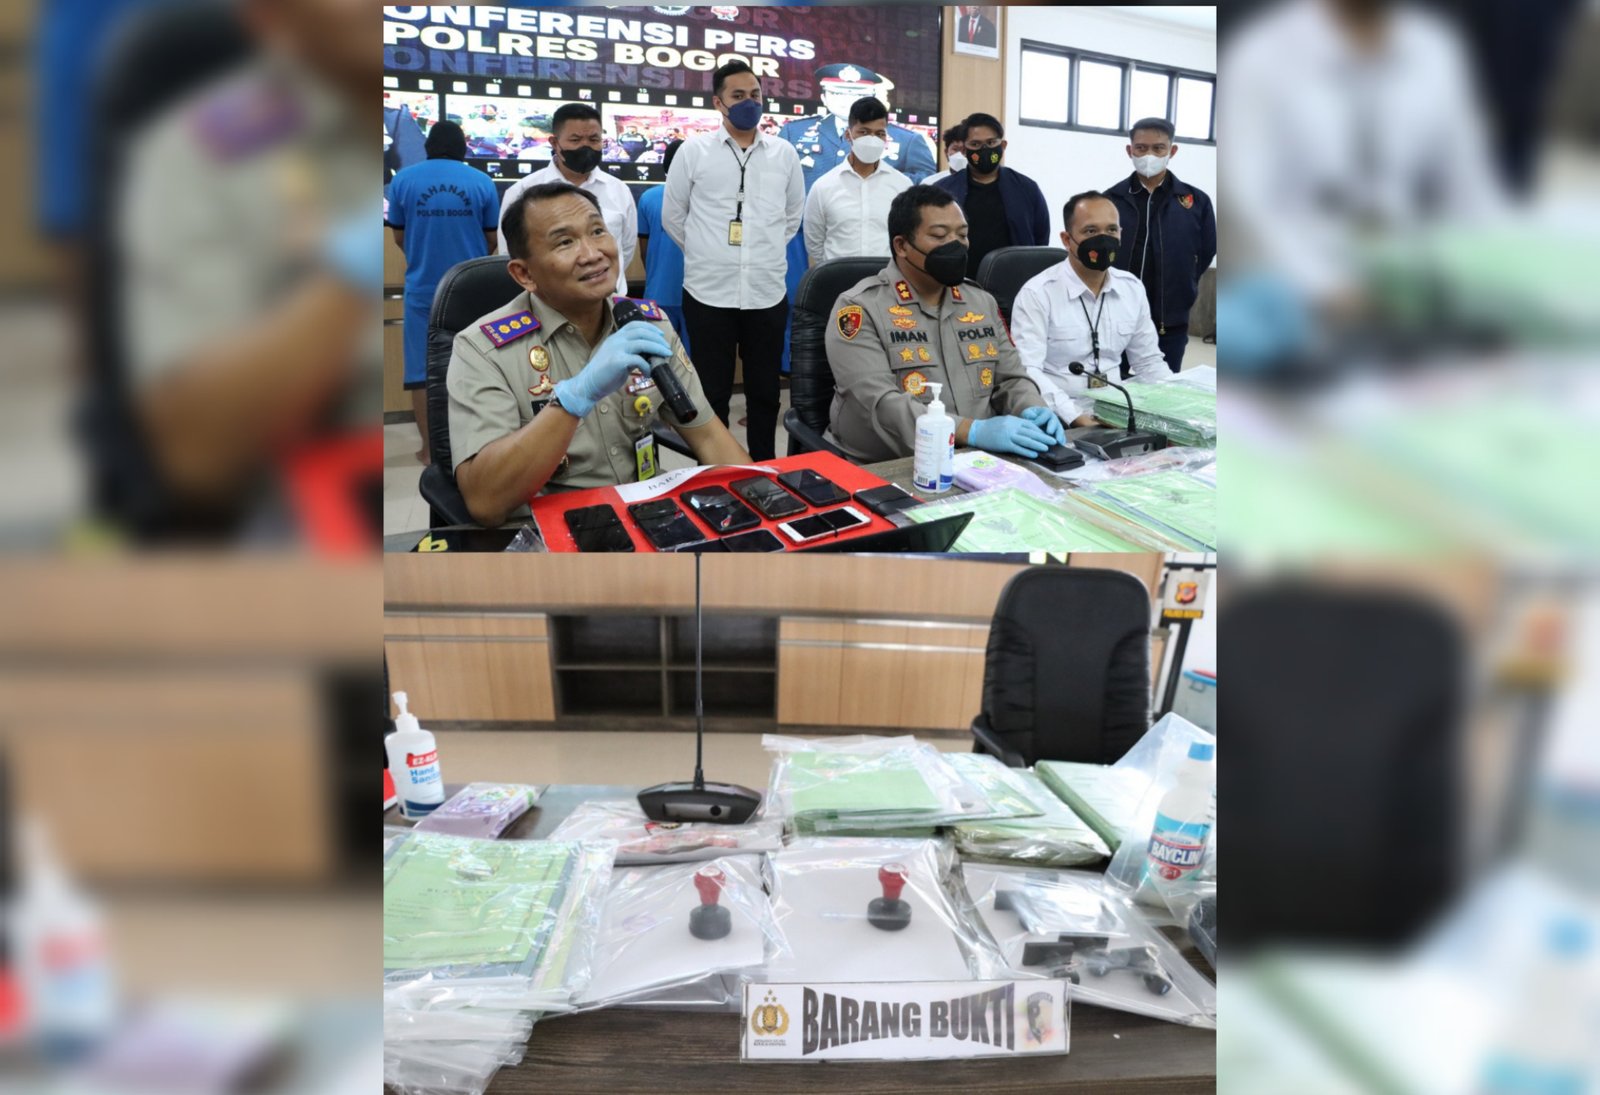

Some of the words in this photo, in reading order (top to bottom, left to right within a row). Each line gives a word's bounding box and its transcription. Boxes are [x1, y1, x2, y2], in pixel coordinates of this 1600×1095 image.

[384, 20, 598, 61] POLRES
[705, 28, 815, 60] PERS
[416, 184, 472, 207] TAHANAN
[447, 209, 474, 217] BOGOR
[889, 330, 928, 344] IMAN
[957, 326, 996, 342] POLRI
[1151, 840, 1201, 865] BAYCLIN
[802, 986, 922, 1056] BARANG
[930, 982, 1015, 1052] BUKTI
